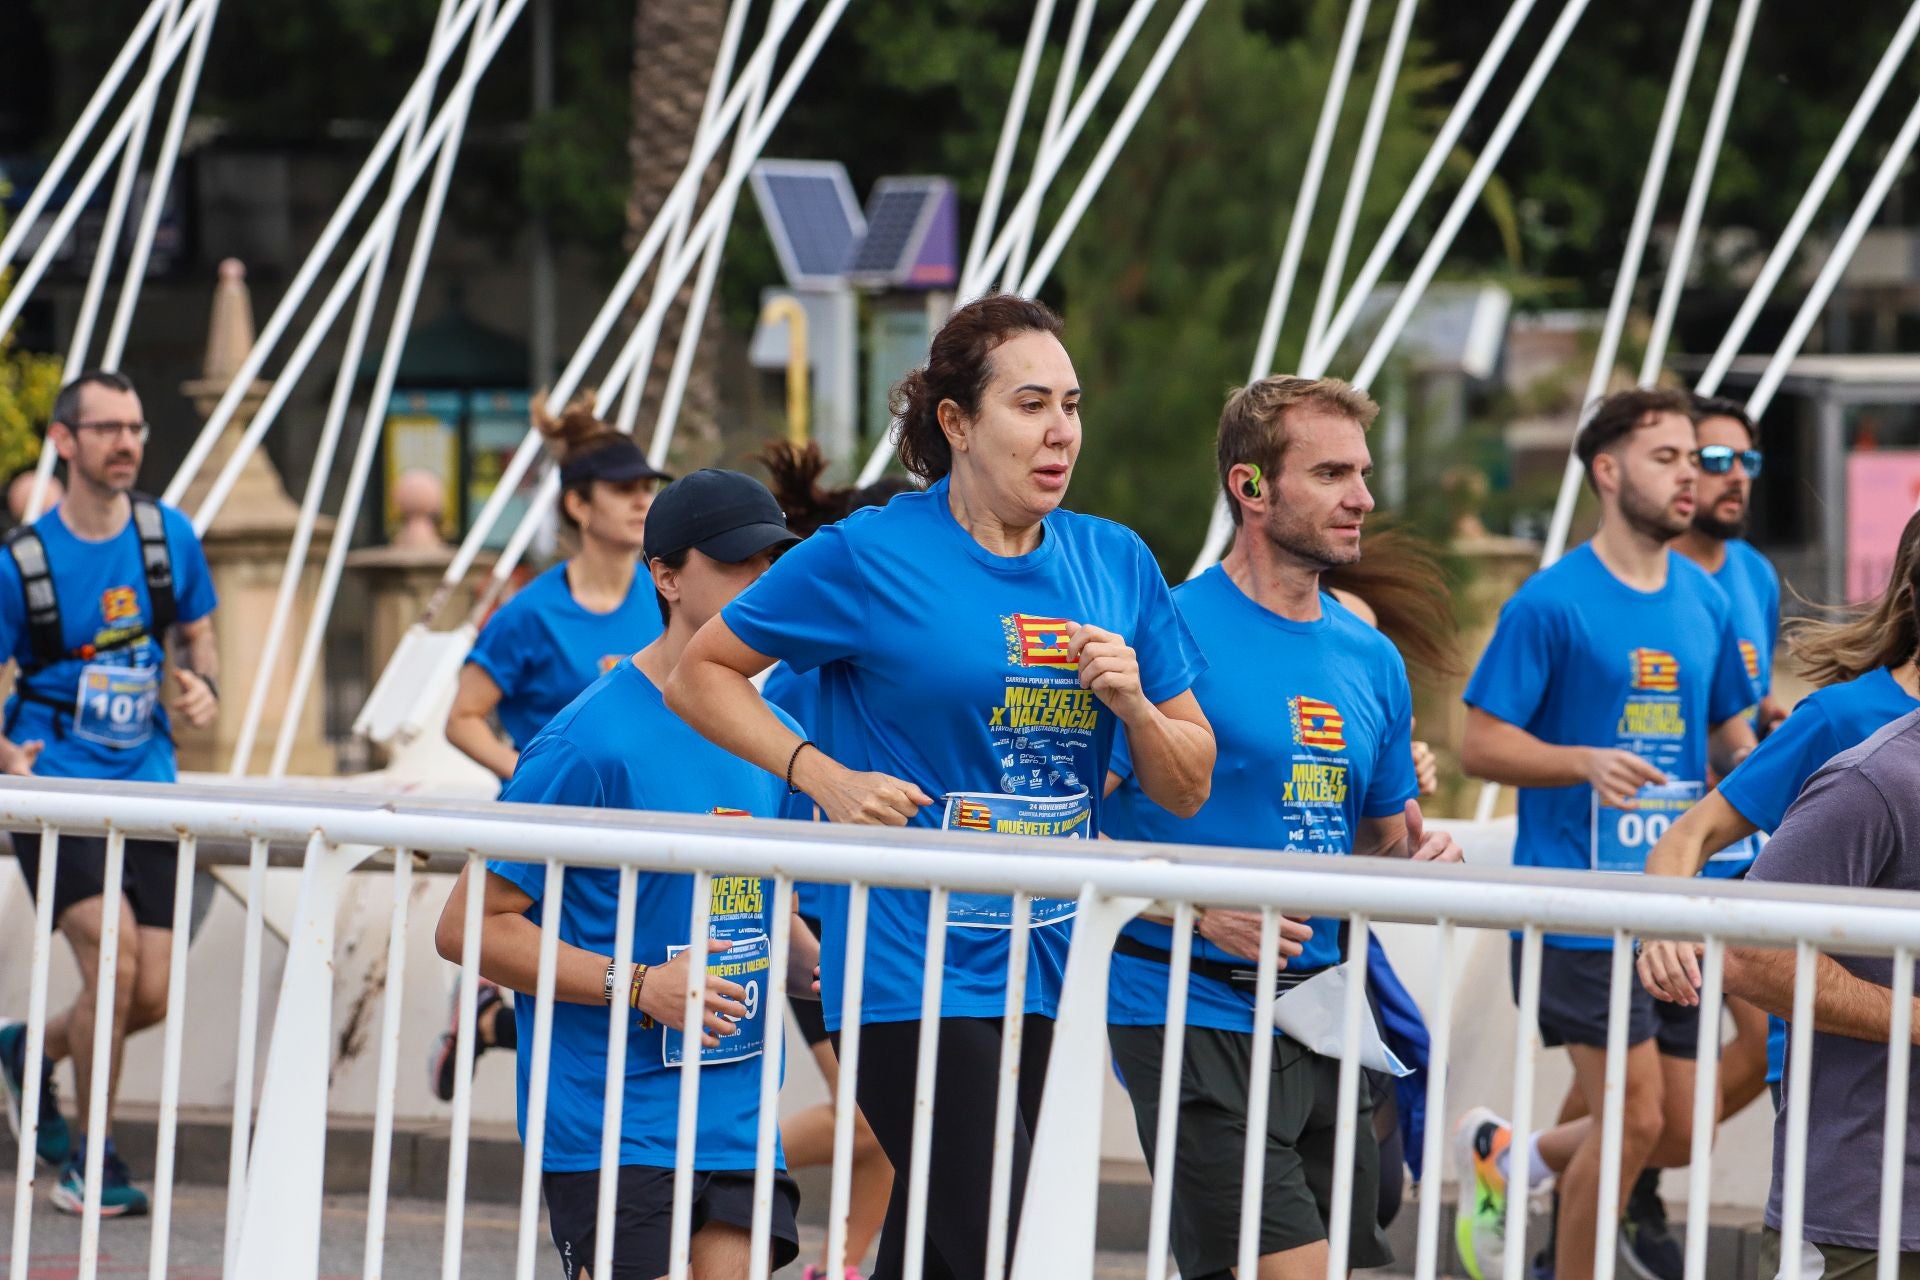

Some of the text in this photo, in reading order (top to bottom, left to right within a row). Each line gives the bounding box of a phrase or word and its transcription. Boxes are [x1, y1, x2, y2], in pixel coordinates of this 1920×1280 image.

[1005, 676, 1028, 684] CARRERA
[1029, 677, 1050, 685] POPULAR
[1005, 684, 1094, 710] MUÉVETE
[989, 707, 1099, 729] X VALENCIA
[1281, 782, 1295, 801] X
[997, 819, 1051, 835] MUÉVETE
[1052, 822, 1061, 834] X
